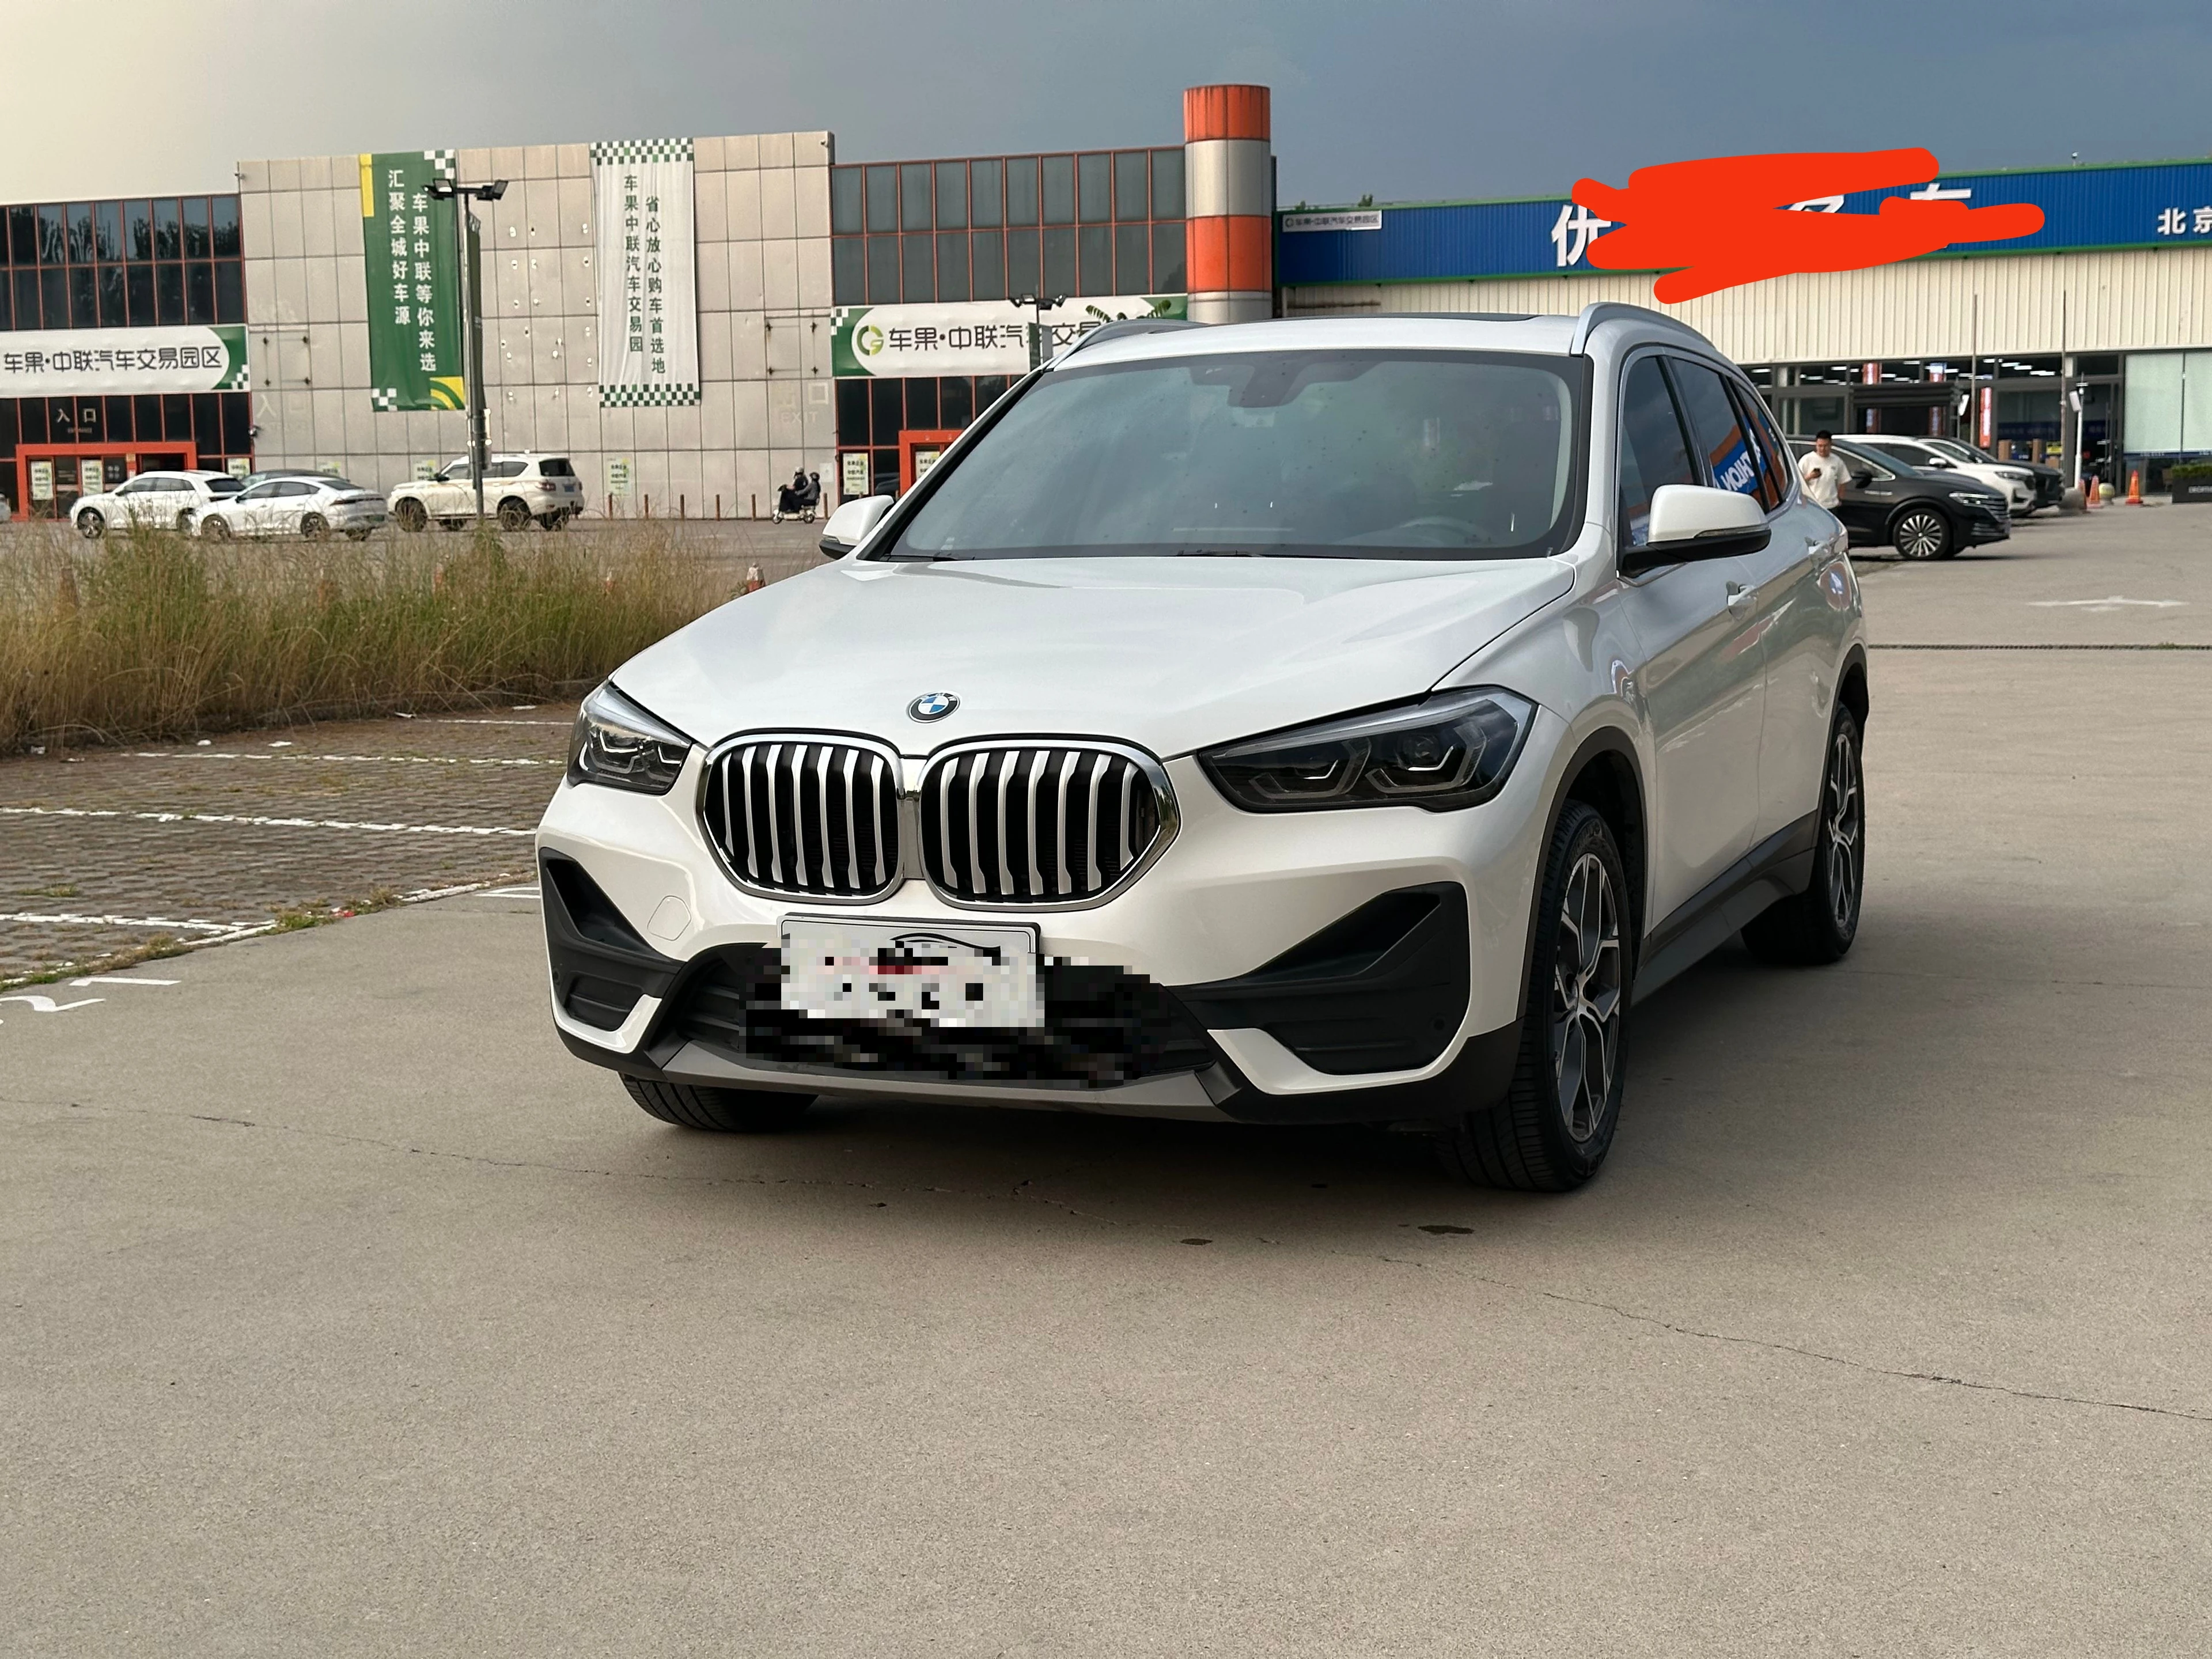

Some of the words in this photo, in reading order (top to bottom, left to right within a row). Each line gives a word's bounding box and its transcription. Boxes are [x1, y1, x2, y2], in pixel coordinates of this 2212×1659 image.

[389, 169, 411, 325] 汇聚全城好车源
[412, 192, 437, 372] 车果中联等你来选
[624, 174, 643, 352] 车果中联汽车交易园
[646, 195, 665, 374] 省心放心购车首选地
[2157, 206, 2212, 235] 北京
[3, 346, 222, 373] 车果·中联汽车交易园区
[56, 408, 97, 423] 入口
